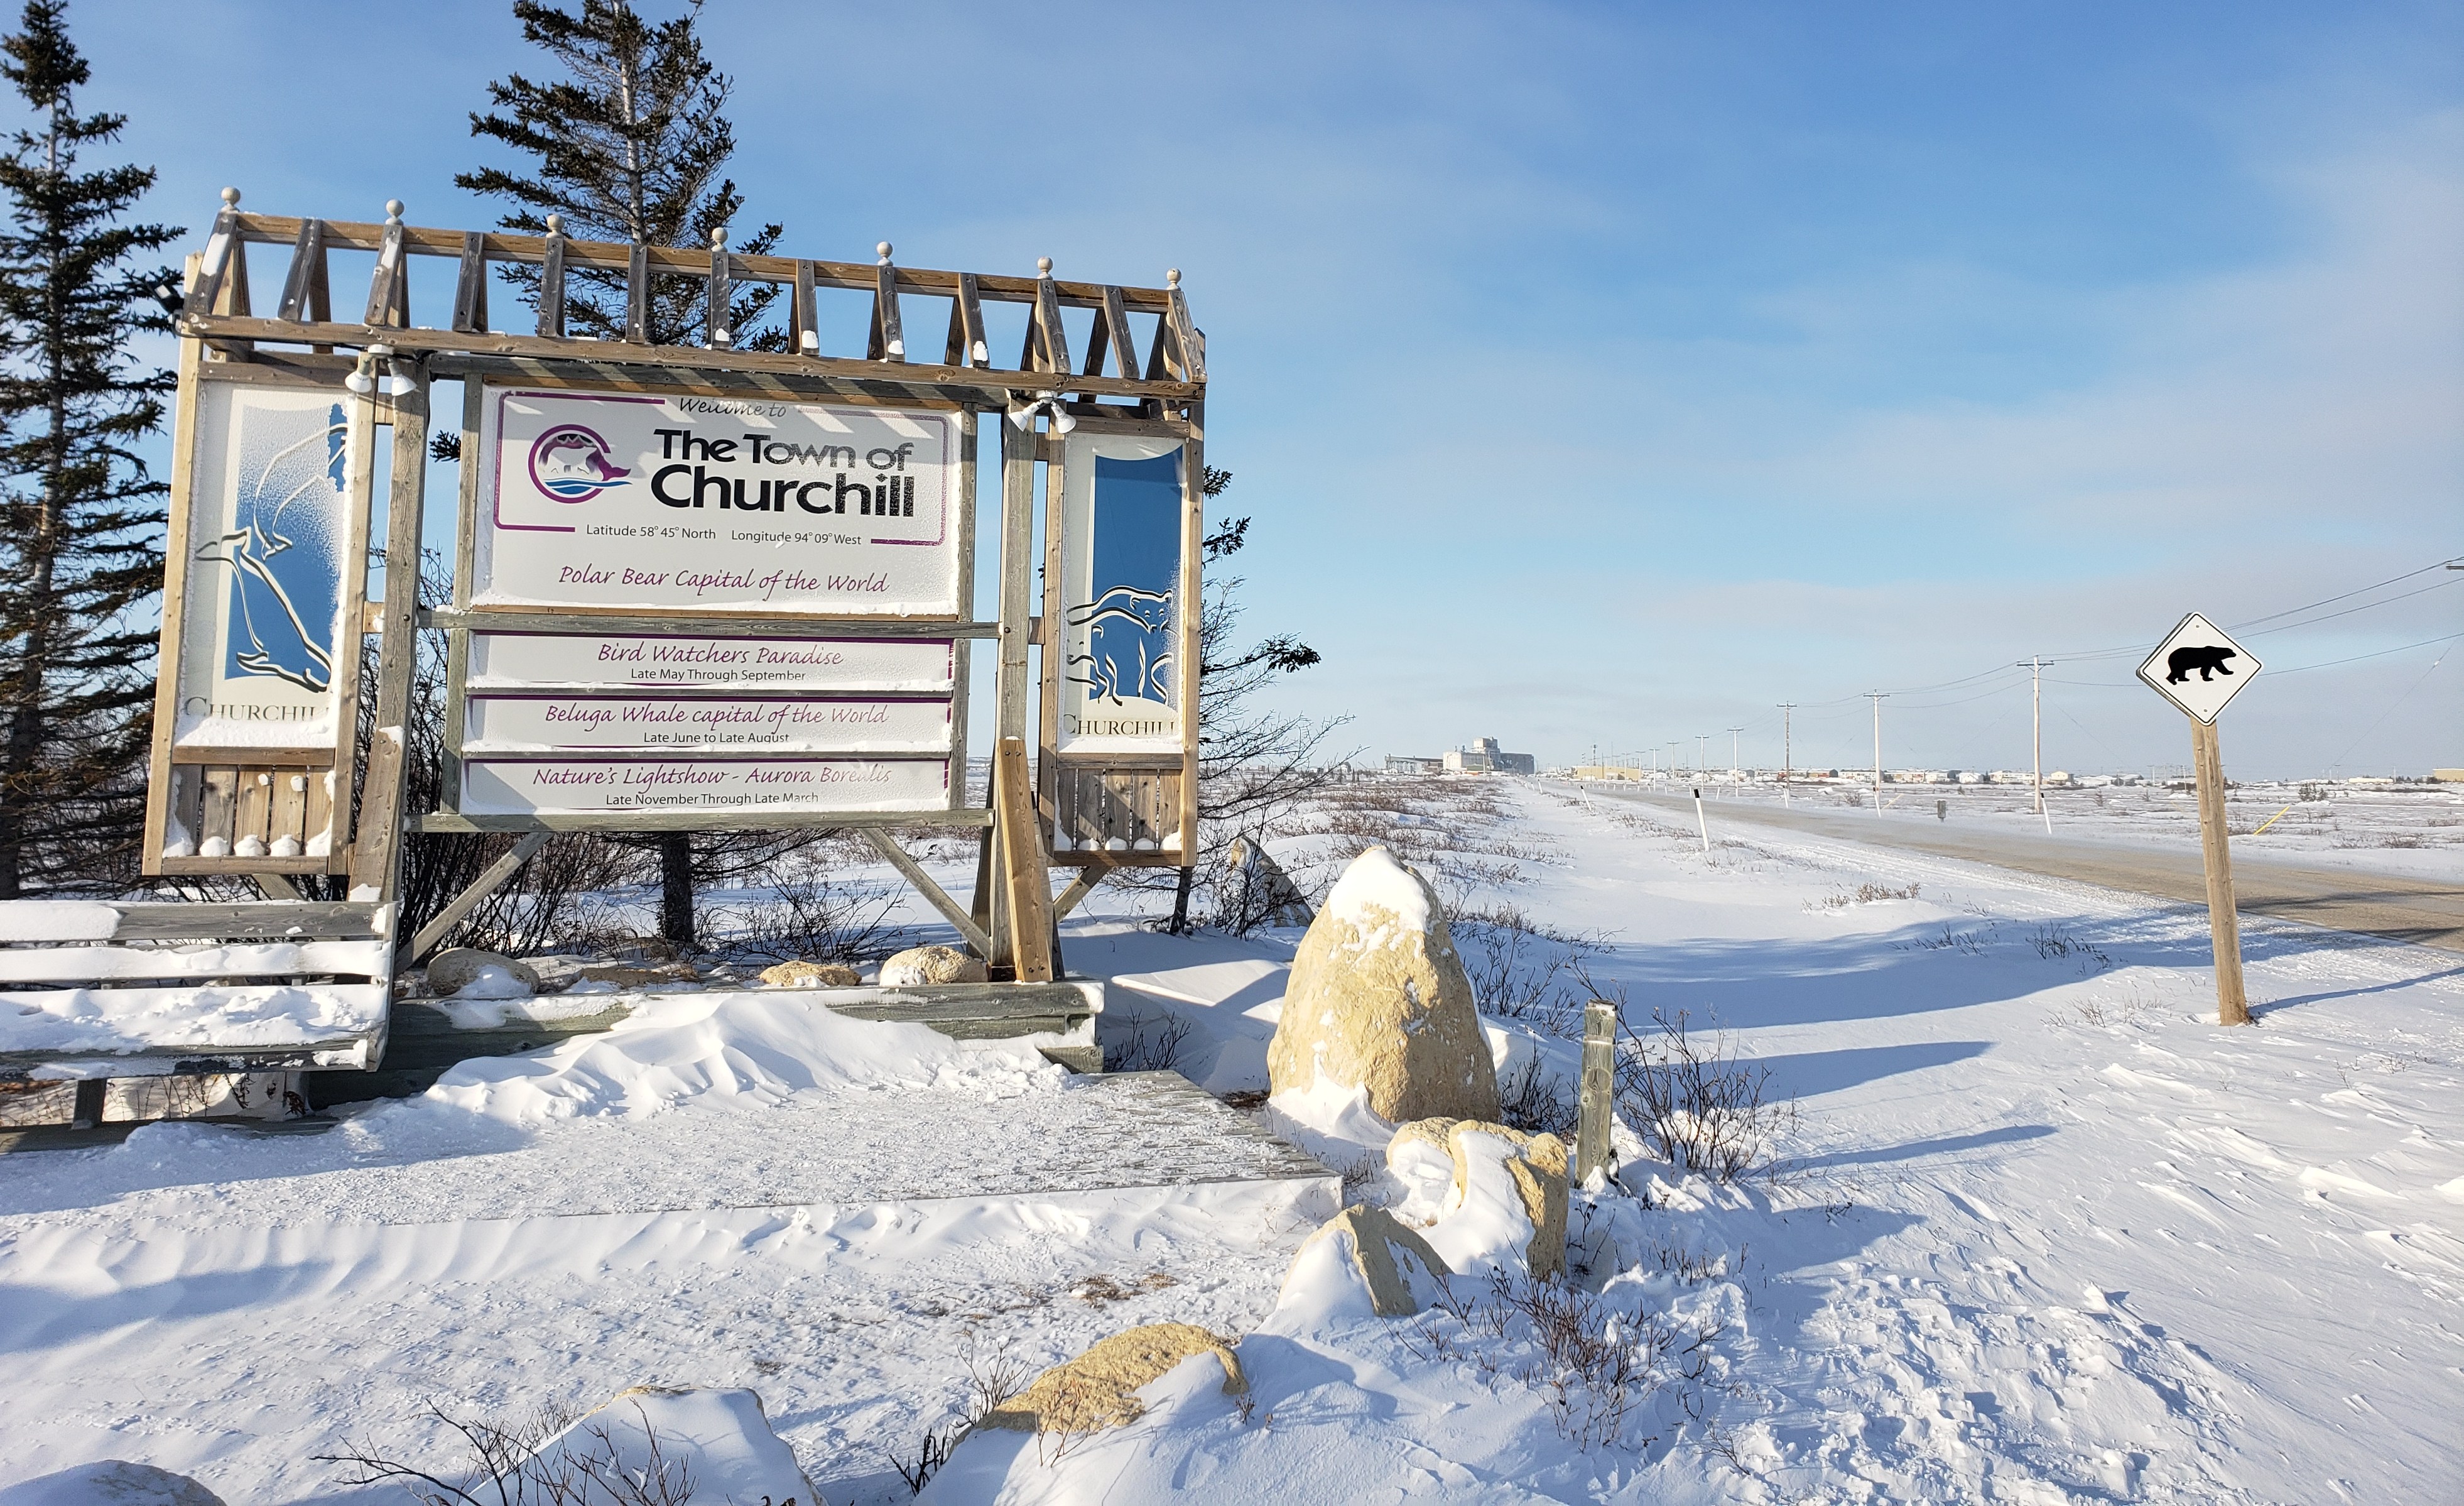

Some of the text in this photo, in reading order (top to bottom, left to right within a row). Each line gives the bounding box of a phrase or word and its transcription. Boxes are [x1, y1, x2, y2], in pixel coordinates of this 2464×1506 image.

[769, 402, 786, 417] to
[653, 428, 915, 471] The Town of
[651, 464, 915, 516] Churchill
[587, 524, 637, 536] Latitude
[681, 528, 716, 539] North
[732, 530, 791, 543] Longitude
[833, 534, 862, 545] West
[558, 563, 890, 601] Polar Bear Capital of the World
[598, 641, 844, 665] Bird Watchers Paradise
[631, 668, 806, 683] Late May Through September
[185, 696, 330, 721] CHURCHIL
[545, 702, 889, 734] Beluga Whale capital of the World
[644, 732, 790, 744] Late June to Late August
[622, 764, 730, 794] Lightshow
[745, 767, 815, 783] Aurora
[606, 792, 819, 806] Late November Through Late March
